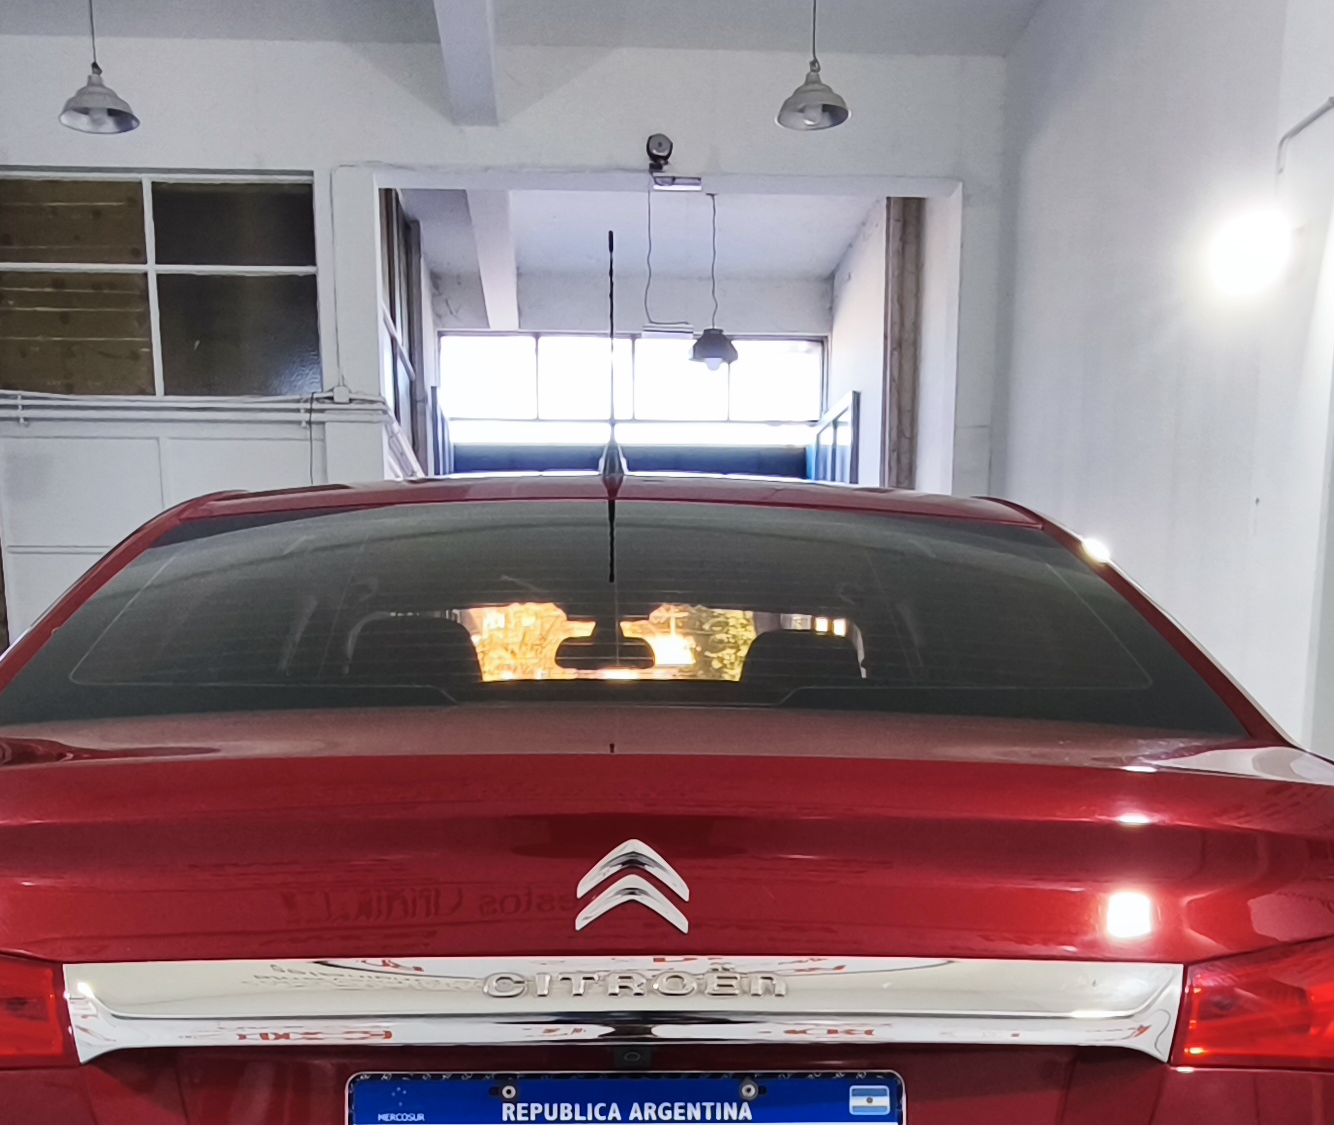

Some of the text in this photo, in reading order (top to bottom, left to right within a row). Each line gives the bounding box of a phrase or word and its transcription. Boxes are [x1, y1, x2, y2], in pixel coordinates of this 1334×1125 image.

[378, 1113, 425, 1122] MERCOSUR
[502, 1102, 753, 1122] REPUBLICA ARGENTINA
